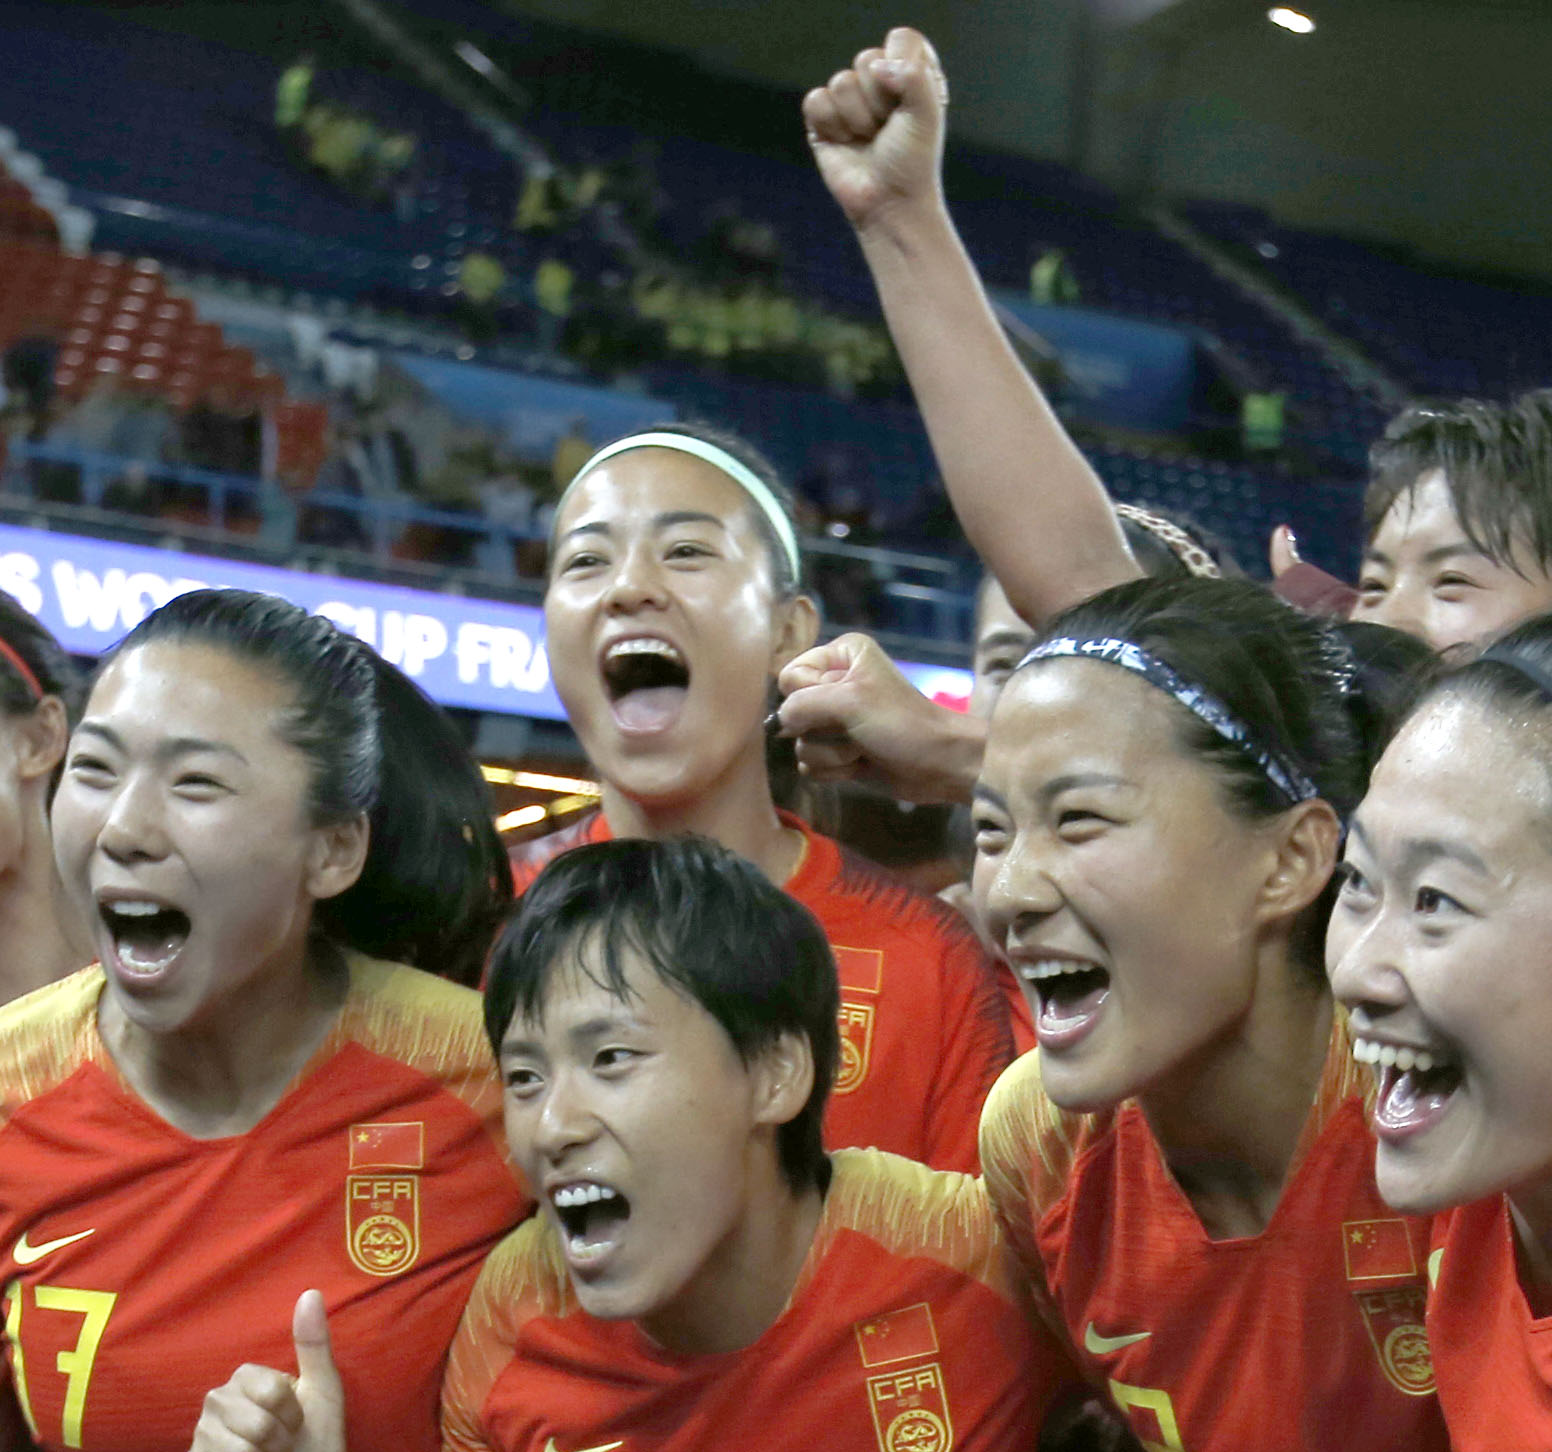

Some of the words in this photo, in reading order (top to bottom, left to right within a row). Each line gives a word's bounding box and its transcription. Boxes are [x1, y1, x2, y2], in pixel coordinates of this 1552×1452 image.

[315, 601, 448, 677] UP
[352, 1182, 411, 1199] CFA
[5, 1280, 118, 1449] 17
[874, 1371, 936, 1401] CFA
